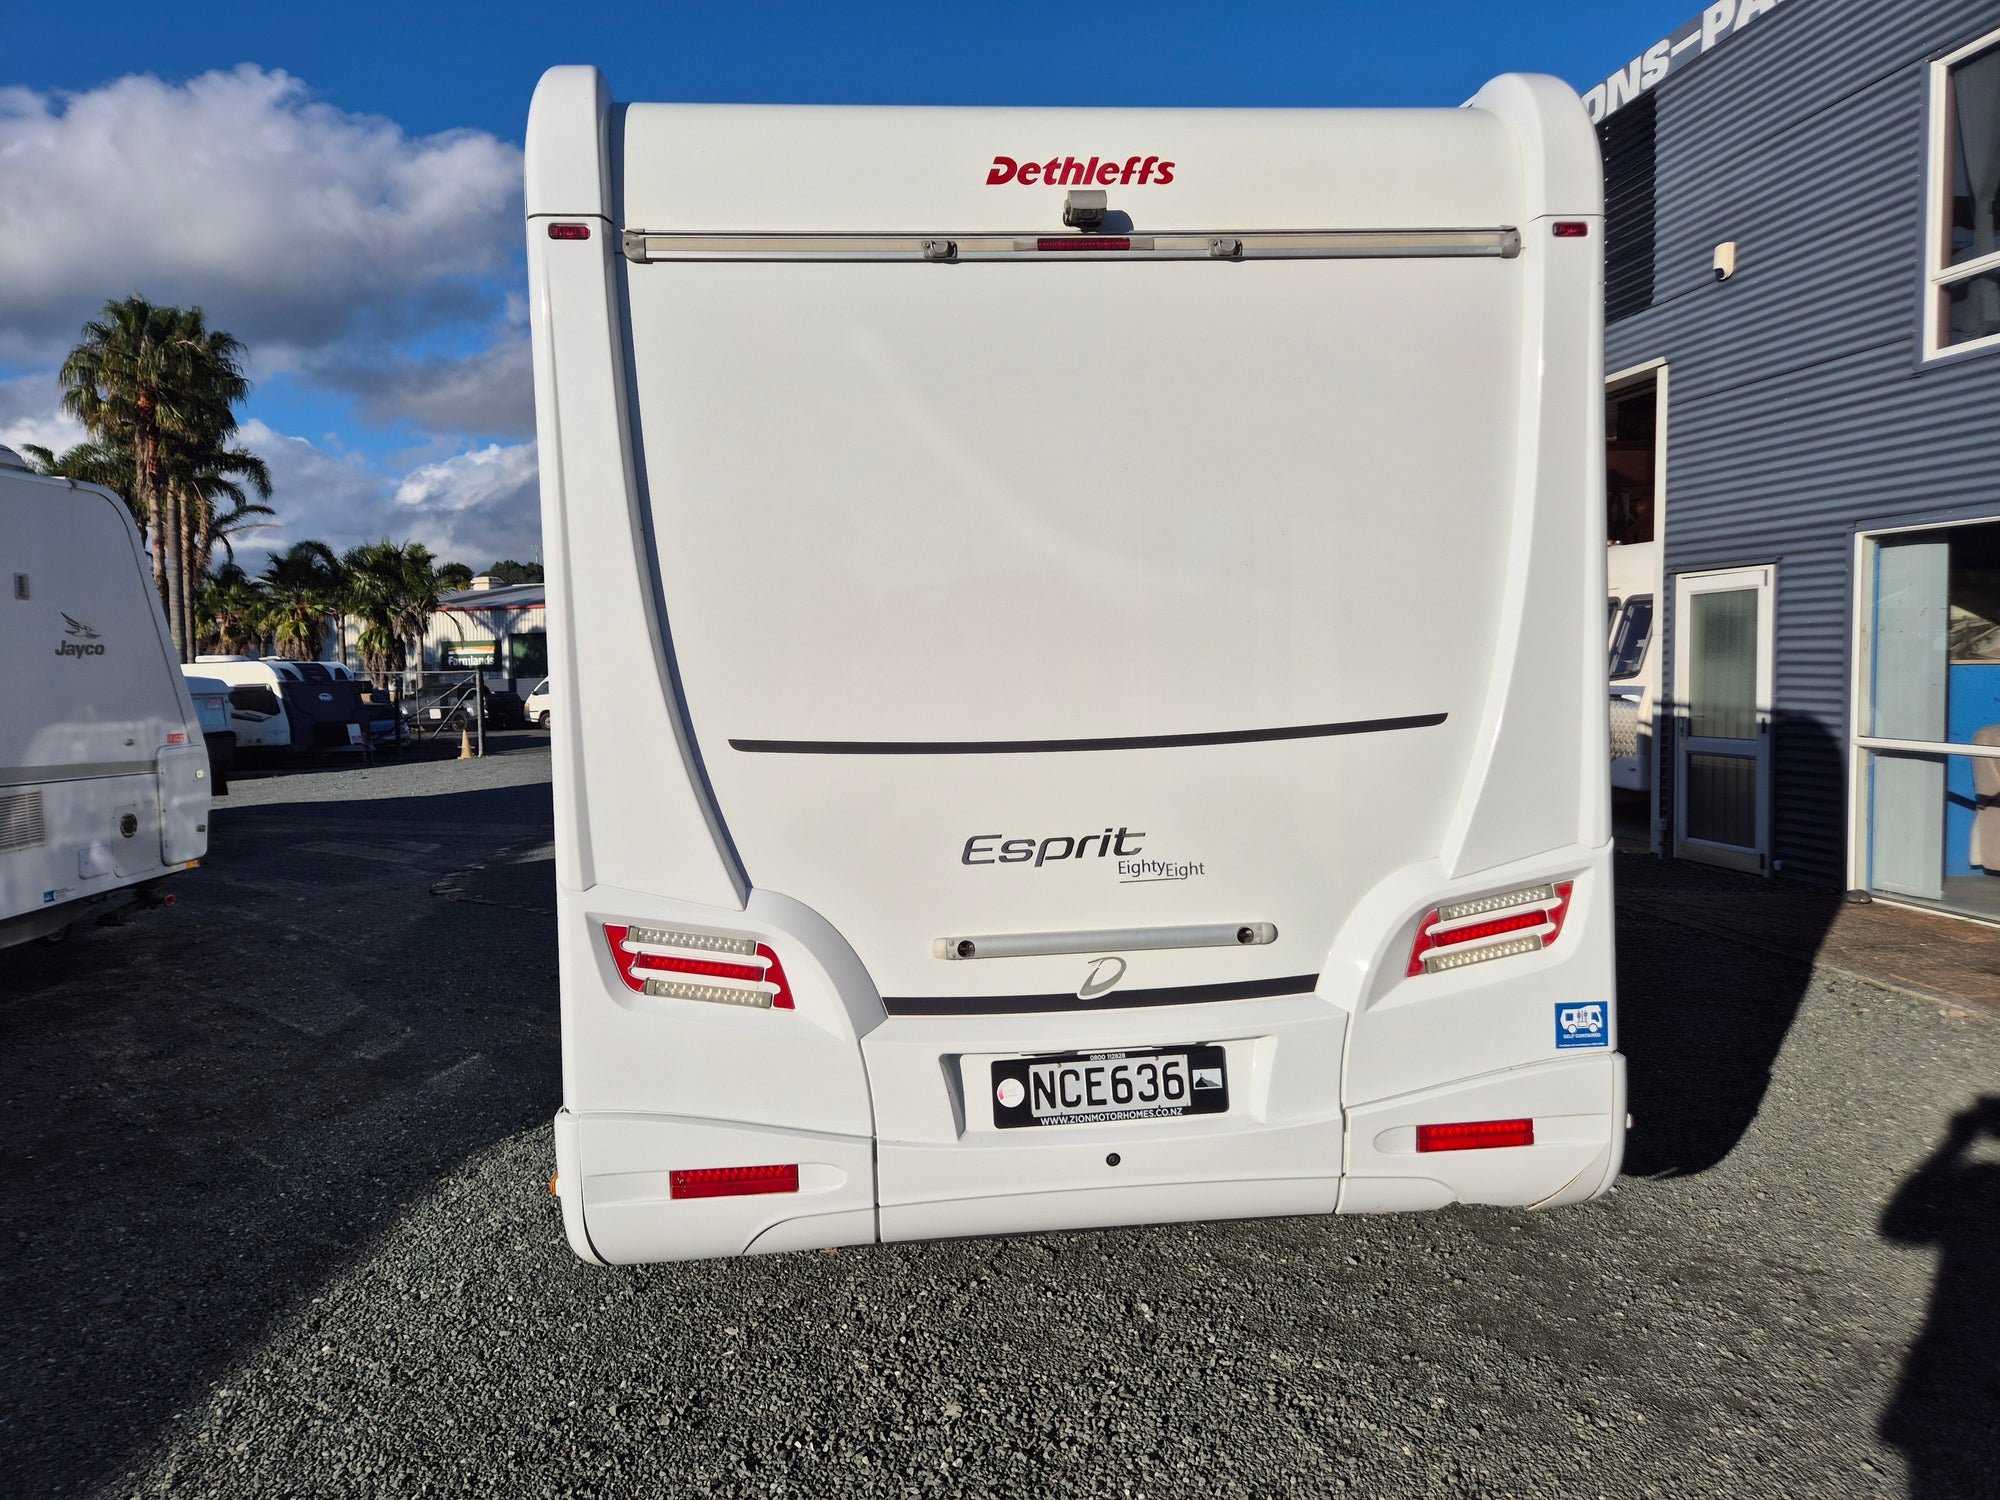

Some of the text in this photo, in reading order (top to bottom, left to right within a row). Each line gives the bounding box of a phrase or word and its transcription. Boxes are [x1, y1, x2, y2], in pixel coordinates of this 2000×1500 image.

[986, 156, 1176, 186] Dethleffs
[55, 640, 104, 659] Jayco
[448, 655, 495, 666] Farmlands
[961, 827, 1146, 868] Esprit
[1033, 1061, 1185, 1110] NCE636
[1040, 1107, 1183, 1126] WWW.ZIONMOTORHOMES.CO.NZ
